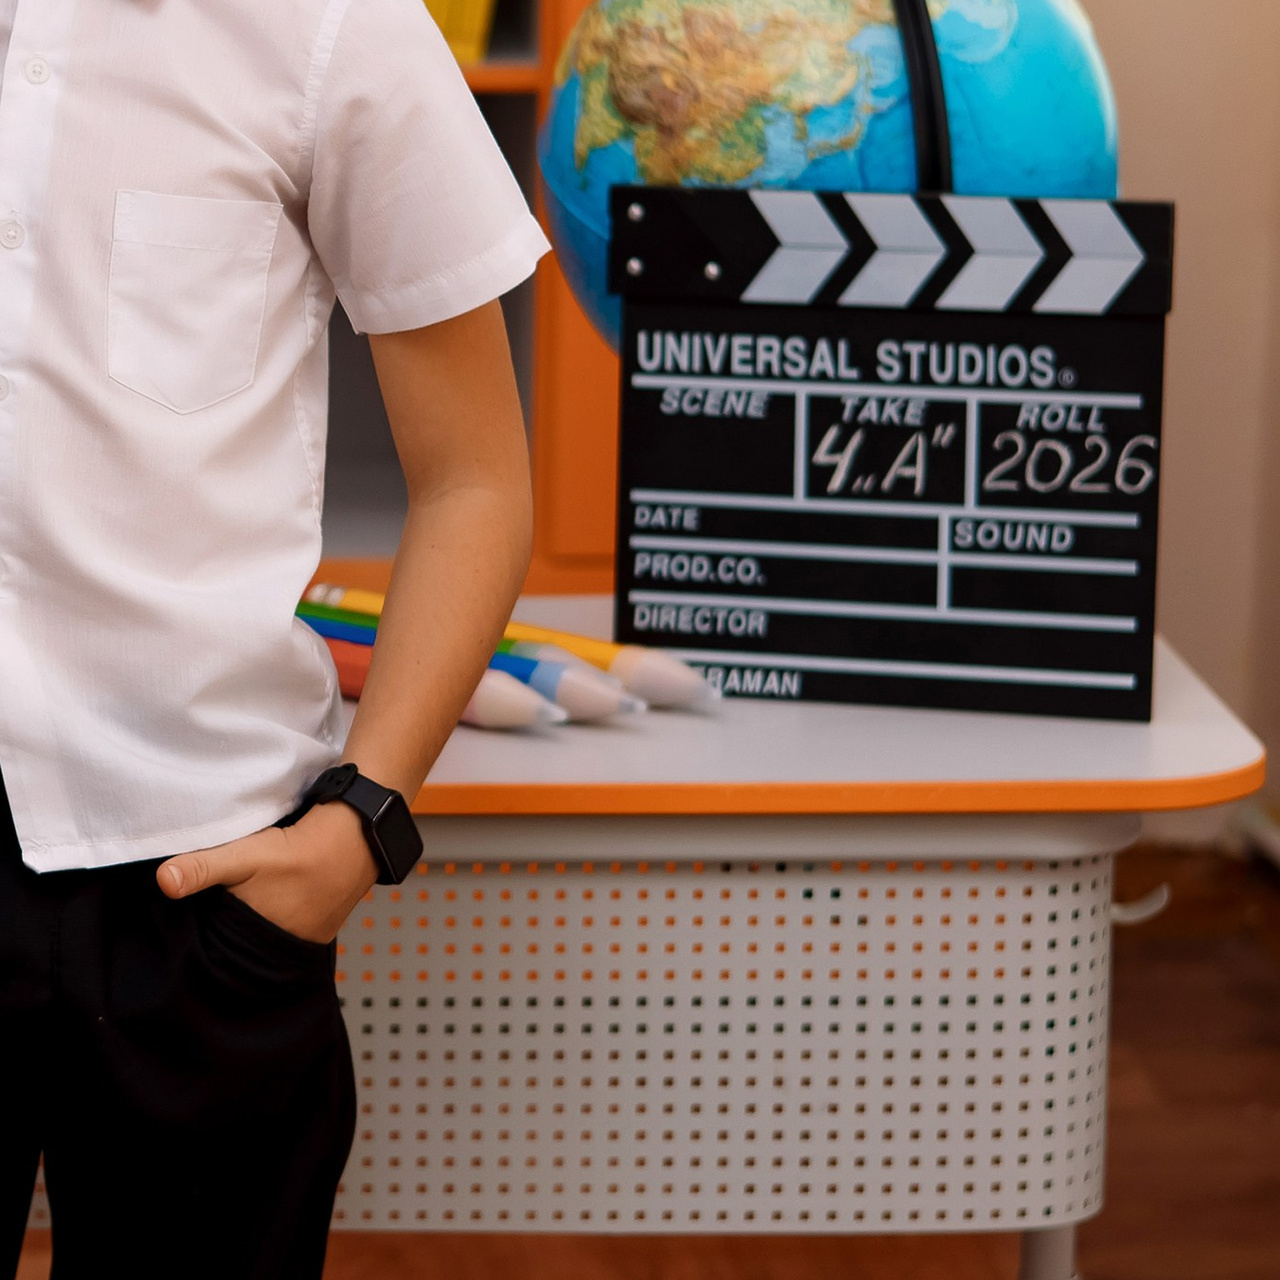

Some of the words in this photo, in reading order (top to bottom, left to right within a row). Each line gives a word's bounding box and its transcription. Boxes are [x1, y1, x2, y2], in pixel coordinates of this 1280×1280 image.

[637, 329, 860, 380] UNIVERSAL
[660, 388, 769, 418] SCENE
[840, 395, 928, 425] TAKE
[1017, 403, 1106, 433] ROLL
[982, 430, 1158, 496] 2026
[634, 505, 699, 531] DATE
[954, 521, 1075, 552] SOUND
[634, 551, 766, 585] PROD.CO.
[633, 604, 767, 637] DIRECTOR
[692, 666, 801, 697] RAMAN
